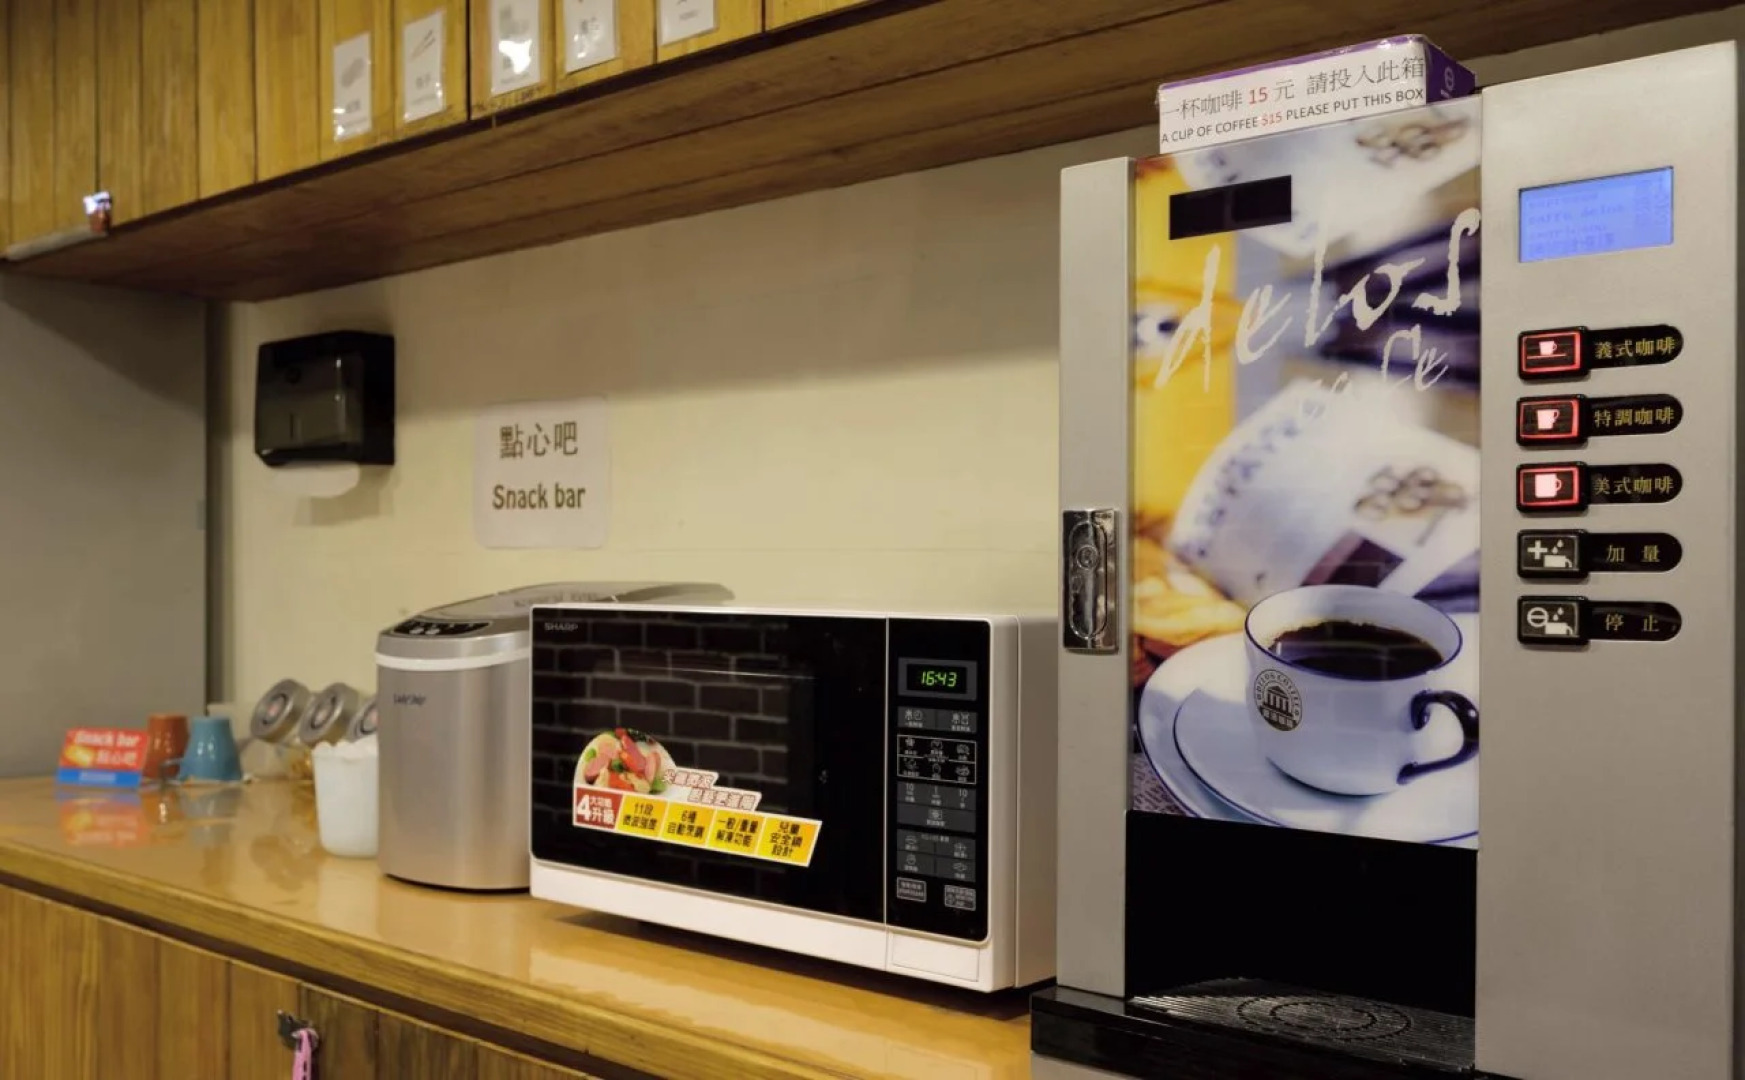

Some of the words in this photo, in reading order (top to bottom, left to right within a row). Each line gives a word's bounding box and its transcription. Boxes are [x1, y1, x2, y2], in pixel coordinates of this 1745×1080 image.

[1162, 89, 1243, 120] 一杯咖啡
[1249, 87, 1268, 104] 15
[1273, 80, 1295, 100] 元
[1307, 56, 1425, 95] 請投入此箱
[1162, 133, 1169, 143] A
[1171, 127, 1194, 140] CUP
[1197, 125, 1213, 137] OF
[1215, 117, 1258, 134] COFFEE
[1261, 112, 1282, 127] $15
[1286, 102, 1330, 120] PLEASE
[1333, 97, 1359, 111] PUT
[1363, 92, 1392, 106] THIS
[1395, 88, 1424, 101] BOX
[1595, 336, 1675, 359] 義式咖啡
[1594, 407, 1675, 428] 特調咖啡
[500, 421, 579, 459] 點心吧
[492, 483, 549, 510] Snack
[554, 482, 586, 509] bar
[1594, 475, 1674, 495] 美式咖啡
[921, 670, 957, 687] 16:43
